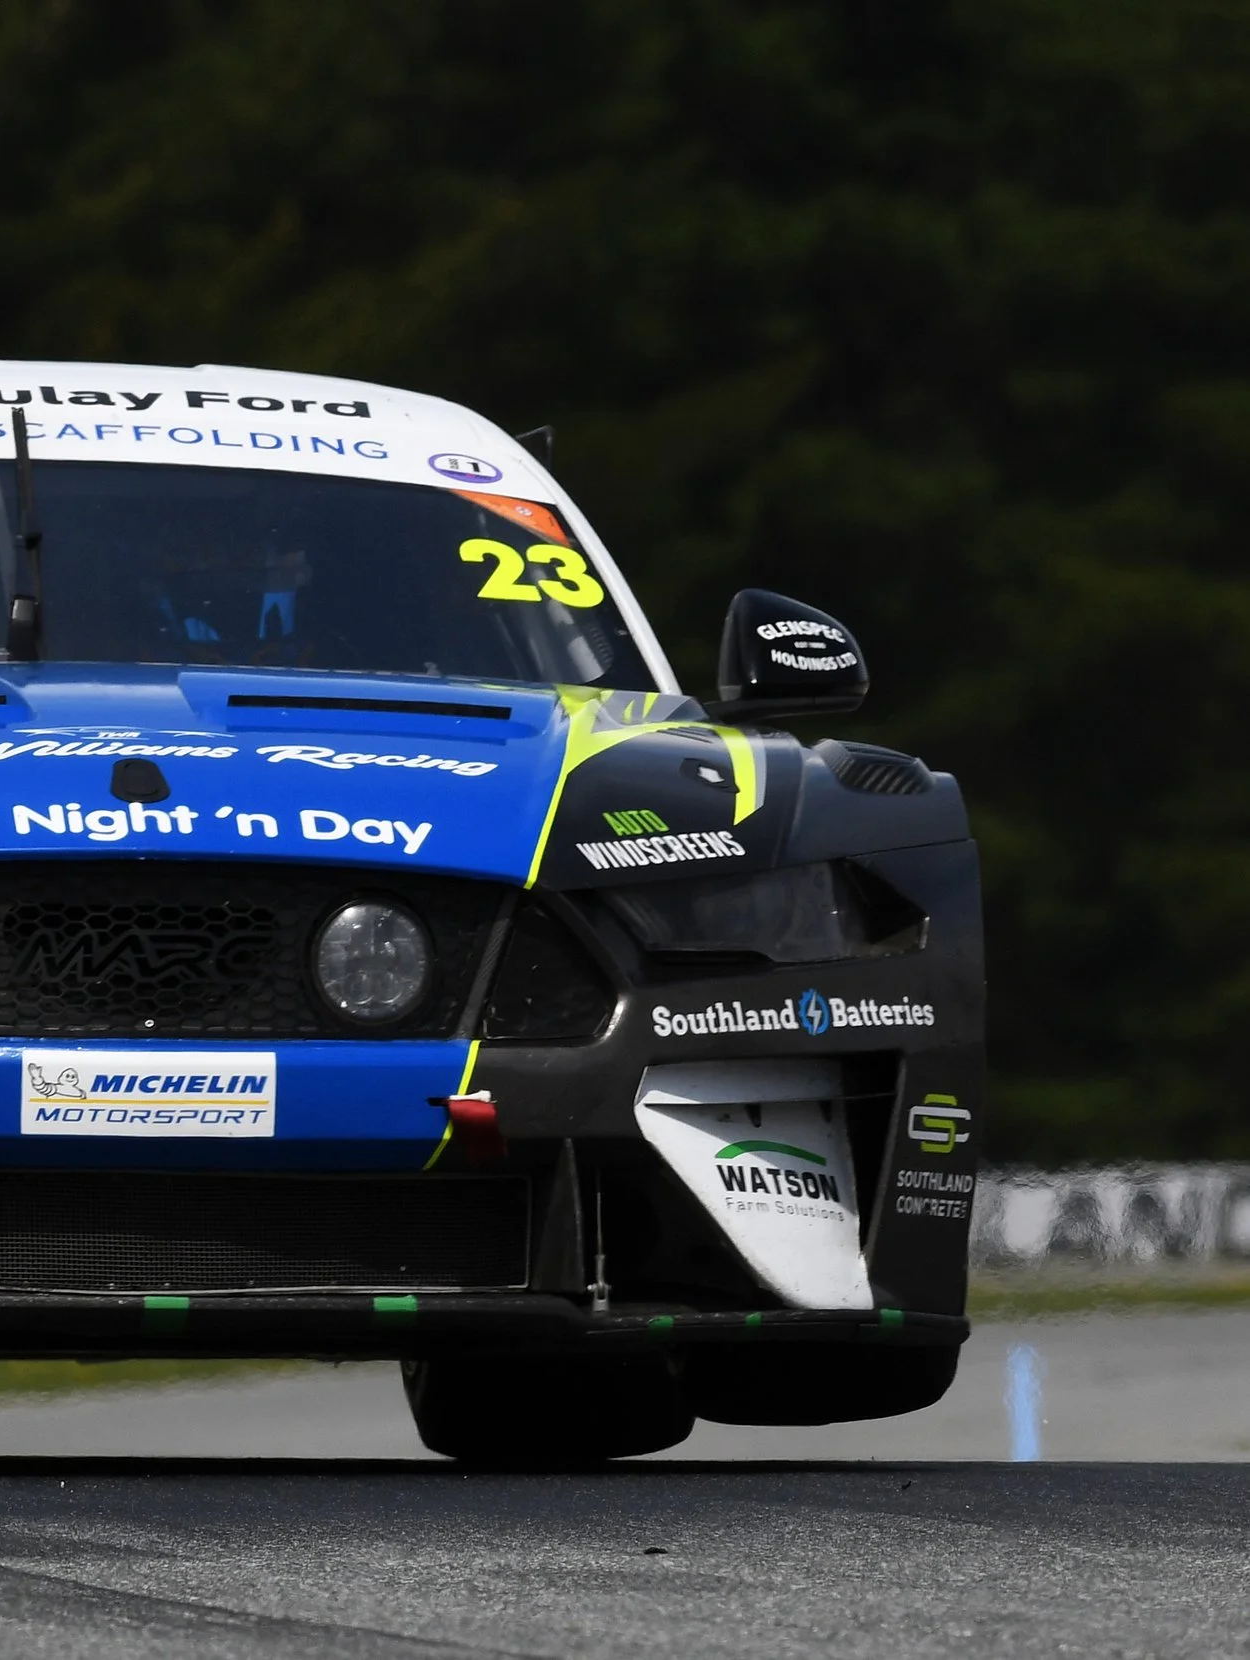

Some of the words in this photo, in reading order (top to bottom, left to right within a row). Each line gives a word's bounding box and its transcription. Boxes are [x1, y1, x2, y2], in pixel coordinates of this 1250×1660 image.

[184, 389, 372, 418] Ford
[458, 538, 605, 608] 23
[756, 620, 846, 643] GLENSPEC
[771, 649, 838, 671] HOLDINGS
[256, 744, 499, 777] Racing
[12, 801, 199, 842] Night
[300, 809, 433, 855] Day
[602, 809, 671, 837] AUTO
[575, 831, 747, 870] WINDSCREENS
[651, 998, 800, 1037] Southland
[828, 996, 935, 1028] Batteries
[89, 1074, 268, 1095] MICHELIN
[35, 1107, 268, 1125] MOTORSPORT
[715, 1164, 841, 1203] WATSON
[896, 1169, 974, 1193] SOUTHLAND
[724, 1197, 771, 1213] Farm
[775, 1200, 846, 1222] Solutions
[895, 1194, 961, 1218] CONCRETE
